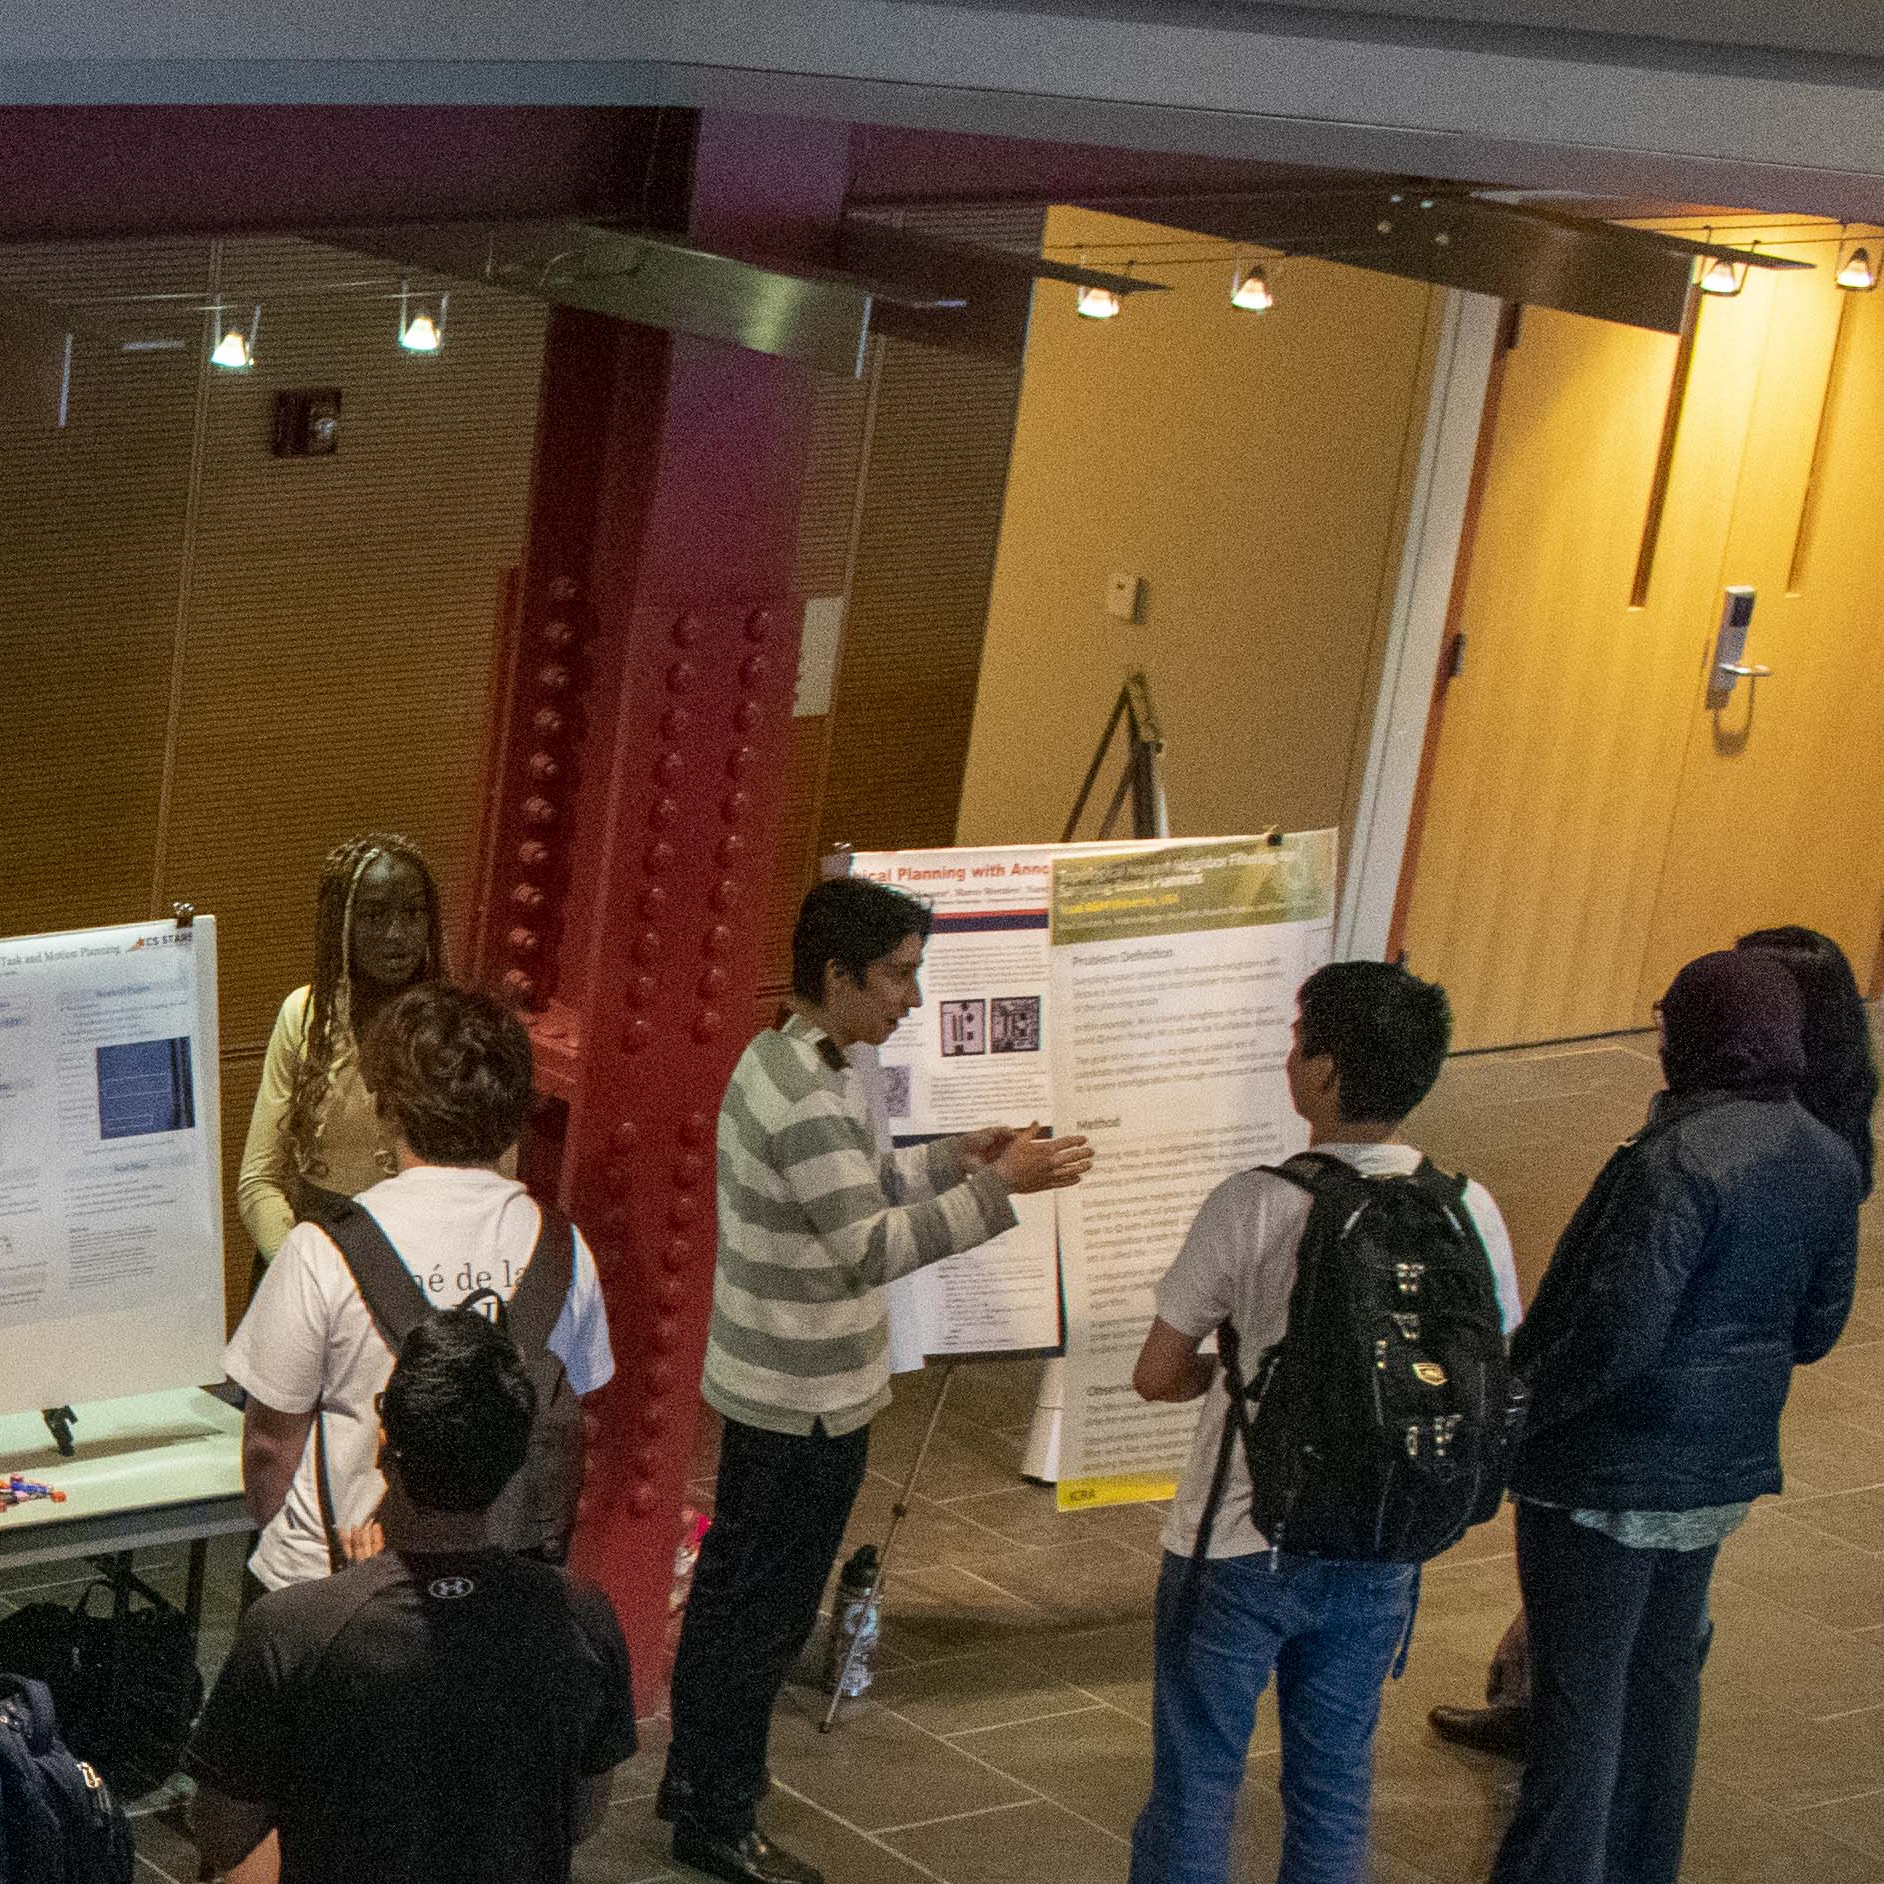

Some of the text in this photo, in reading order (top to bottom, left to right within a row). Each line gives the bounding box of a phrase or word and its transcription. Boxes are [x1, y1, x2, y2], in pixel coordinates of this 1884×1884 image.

[898, 865, 966, 882] Planning
[972, 863, 1004, 877] with
[456, 1262, 492, 1292] de
